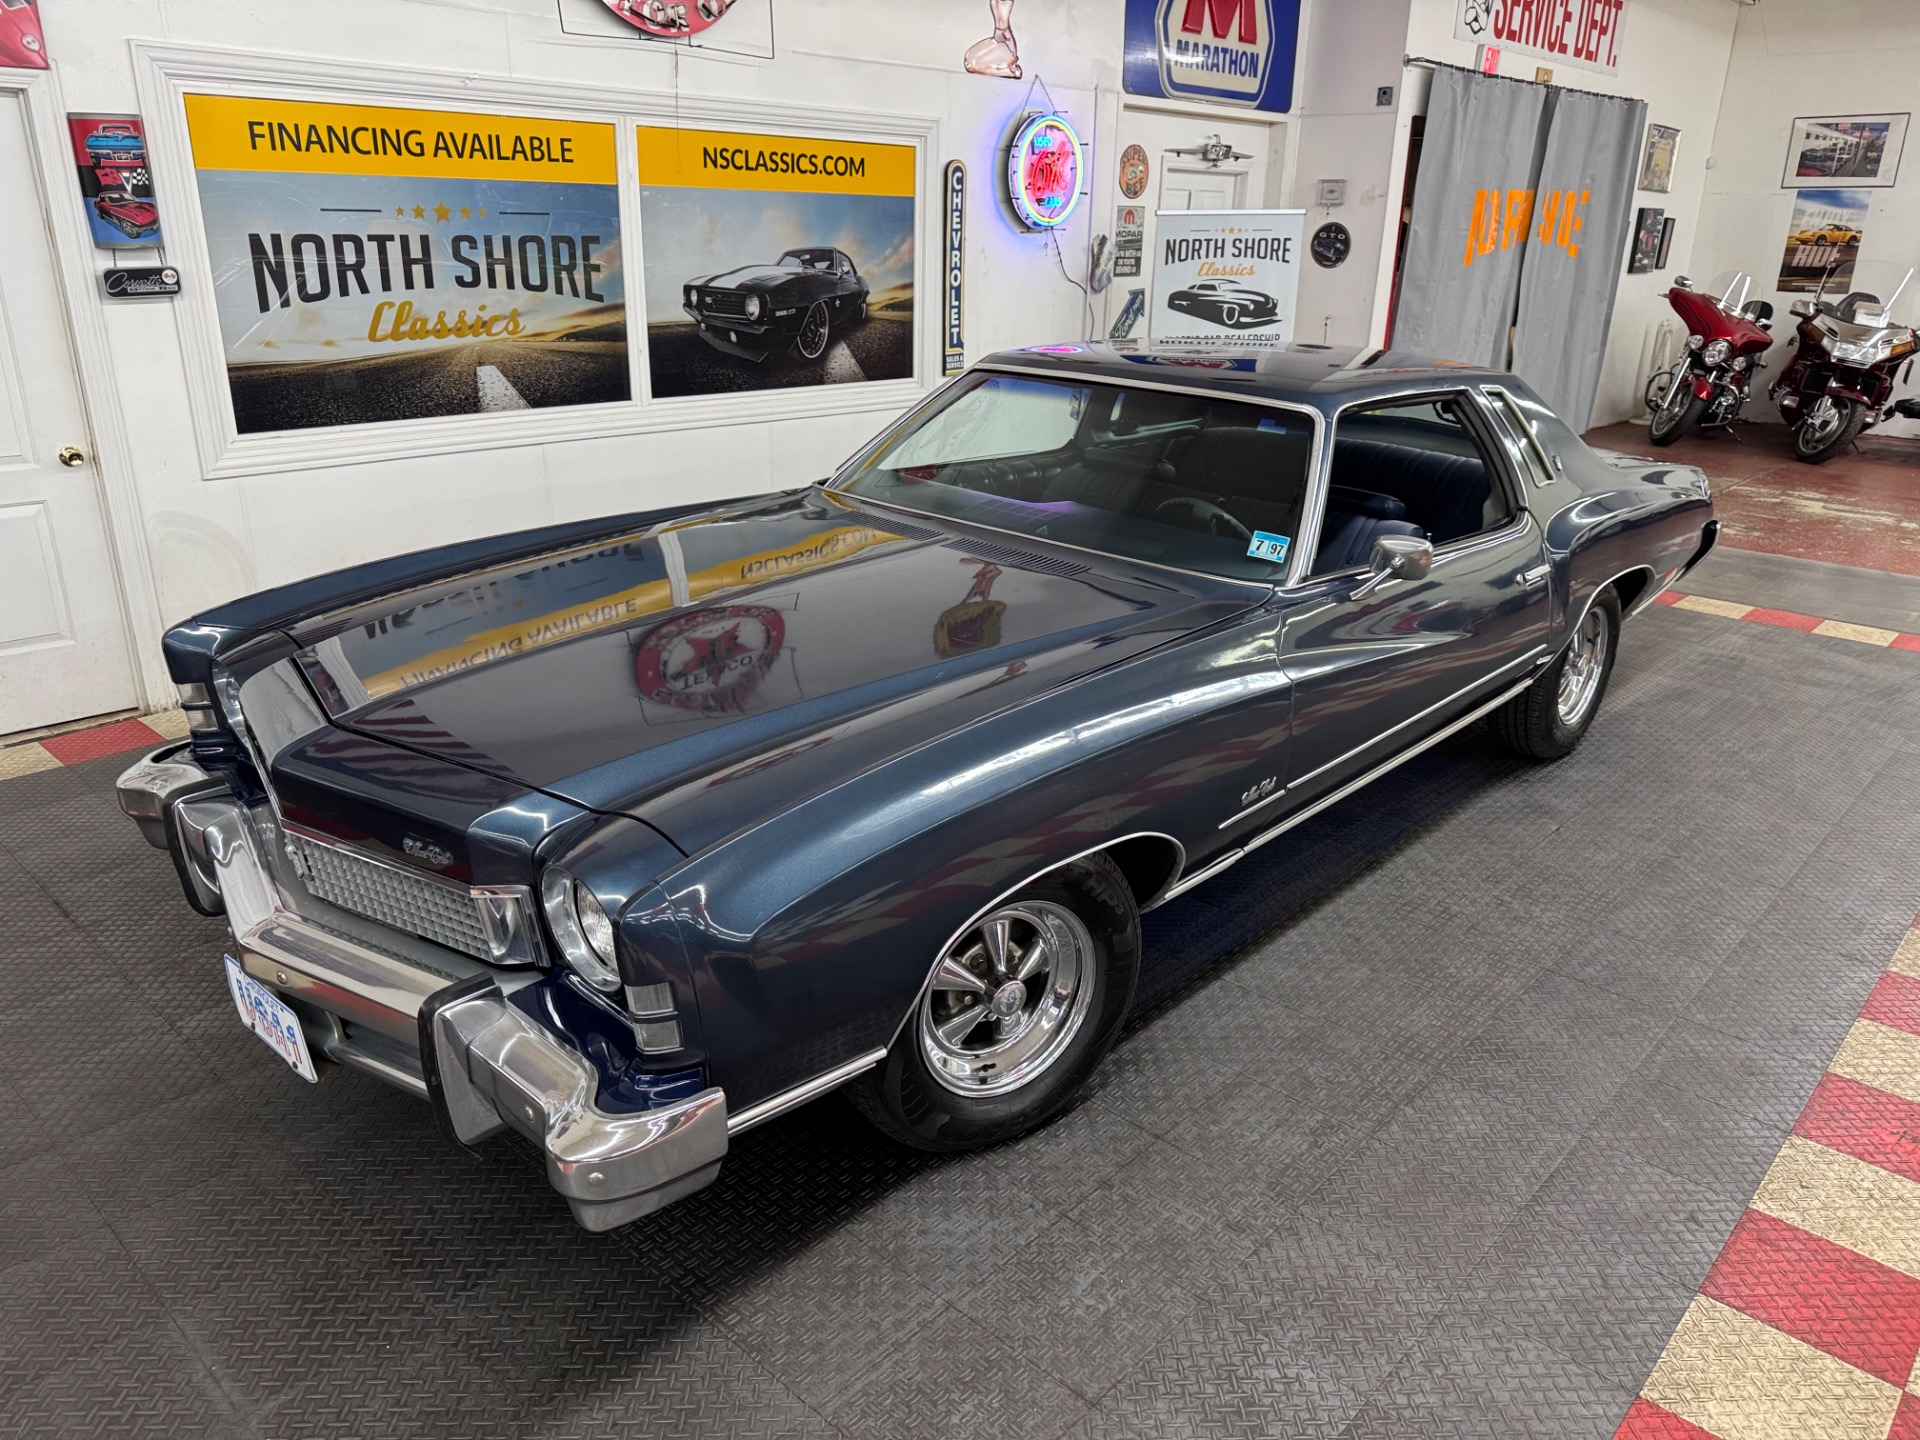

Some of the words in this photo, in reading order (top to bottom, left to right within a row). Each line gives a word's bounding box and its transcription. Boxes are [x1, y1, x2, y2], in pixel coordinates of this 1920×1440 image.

[1493, 0, 1573, 55] SERVICE
[1573, 0, 1624, 68] DEPT.
[1174, 39, 1260, 79] MARATHON
[247, 120, 426, 158] FINANCING
[432, 130, 575, 164] AVAILABLE
[702, 146, 866, 178] NSCLASSICS.COM
[1122, 147, 1145, 175] SUPER
[1125, 177, 1144, 197] BEE
[1115, 230, 1143, 240] MOPAR
[1319, 231, 1346, 240] GTO
[951, 171, 963, 345] CHEVROLET
[1164, 238, 1226, 266] NORTH
[1231, 237, 1292, 264] SHORE
[1791, 245, 1841, 268] RIDE
[106, 272, 165, 293] Corvette
[248, 232, 434, 314] NORTH
[451, 233, 605, 304] SHORE
[1196, 261, 1256, 277] Classics
[367, 299, 527, 343] Classics
[1114, 307, 1135, 338] Ford
[946, 355, 959, 363] SALES
[1255, 539, 1265, 551] 7
[1270, 543, 1284, 556] 97
